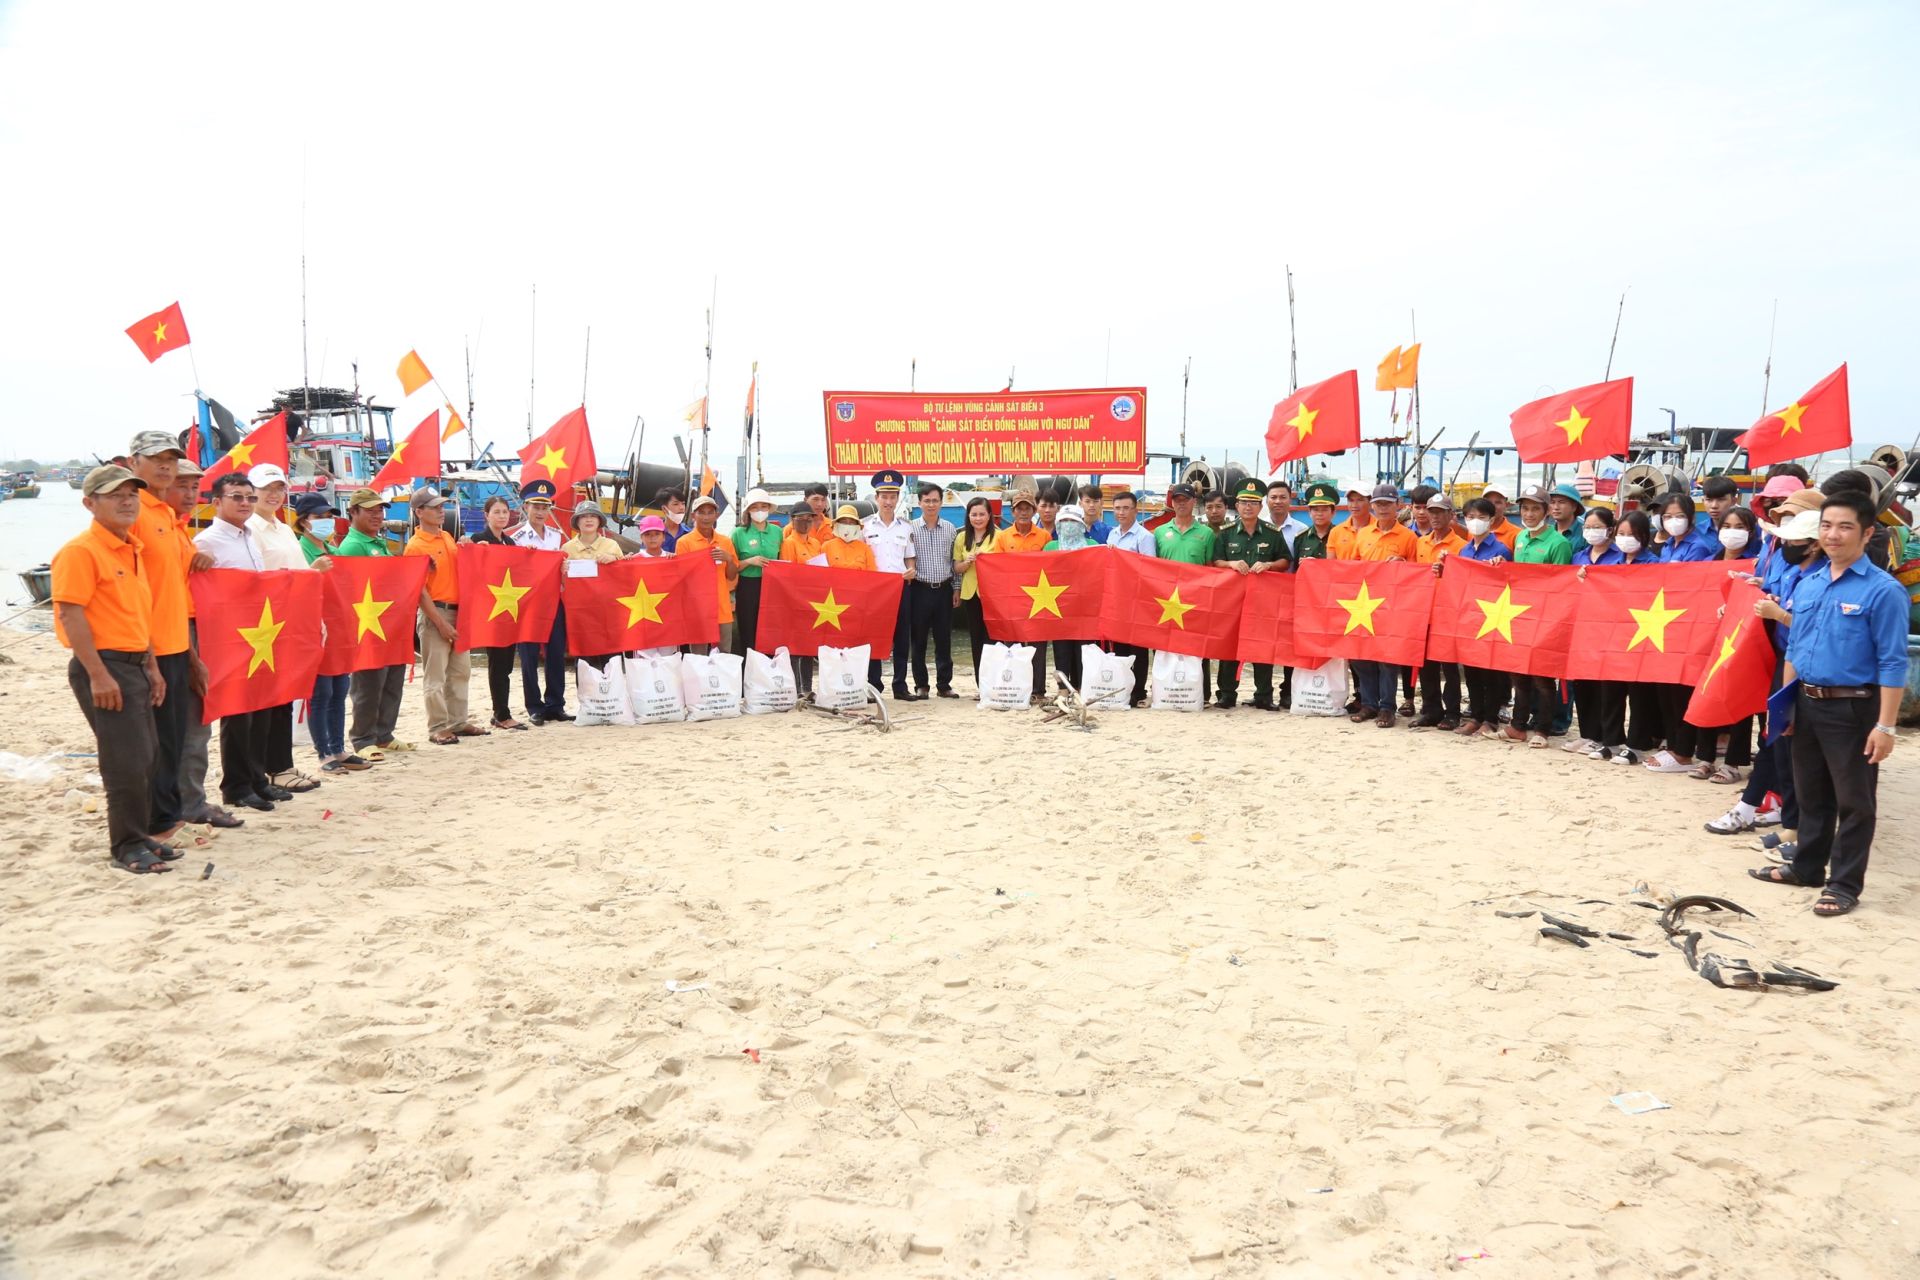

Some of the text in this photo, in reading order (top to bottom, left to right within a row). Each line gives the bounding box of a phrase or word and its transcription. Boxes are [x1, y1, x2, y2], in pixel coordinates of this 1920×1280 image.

[924, 401, 933, 415] BỘ
[935, 402, 944, 413] TƯ
[945, 401, 963, 415] LỆNH
[964, 400, 983, 412] VÙNG
[985, 400, 1004, 412] CẢNH
[1006, 400, 1019, 412] SÁT
[1039, 402, 1044, 412] 3
[875, 419, 905, 432] CHƯƠNG
[907, 418, 930, 432] TRÌNH
[959, 417, 973, 432] SÁT
[1018, 416, 1039, 431] HÀNH
[1055, 417, 1072, 430] NGƯ
[835, 436, 1137, 469] THĂM TẶNG QUÀ CHO NGƯ DÂN XÃ TÂN THUẬN, HUYỆN HÀM THUẬN NAM
